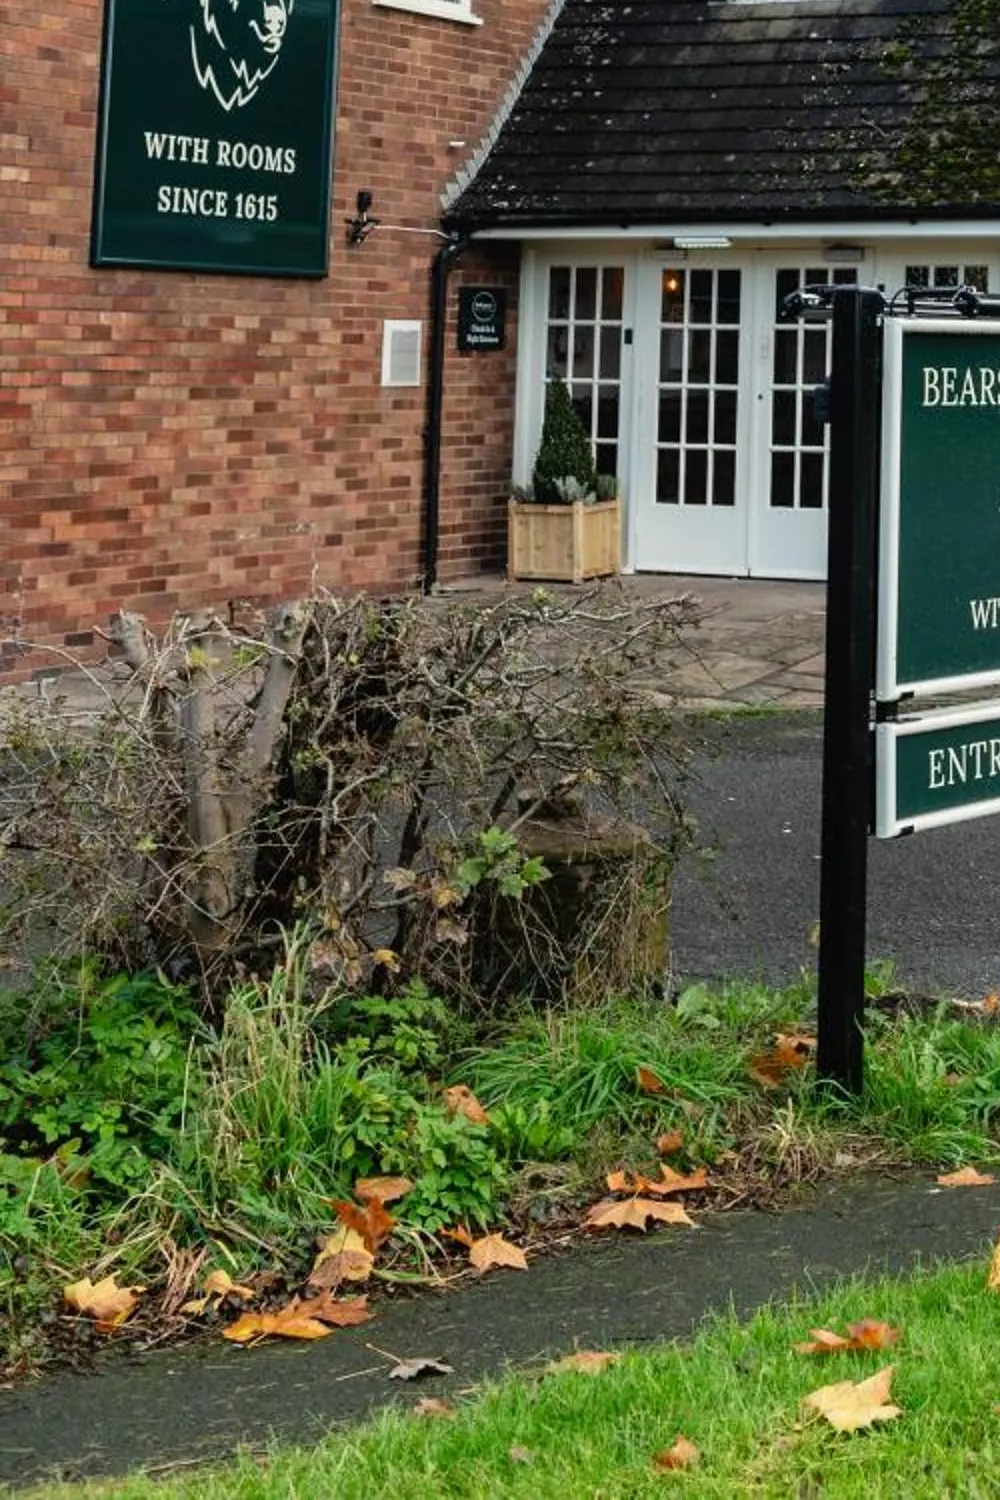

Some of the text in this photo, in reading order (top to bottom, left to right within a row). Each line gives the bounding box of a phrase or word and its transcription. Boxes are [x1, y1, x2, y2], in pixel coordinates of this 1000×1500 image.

[143, 131, 297, 174] WITH ROOMS
[157, 185, 278, 221] SINCE 1615
